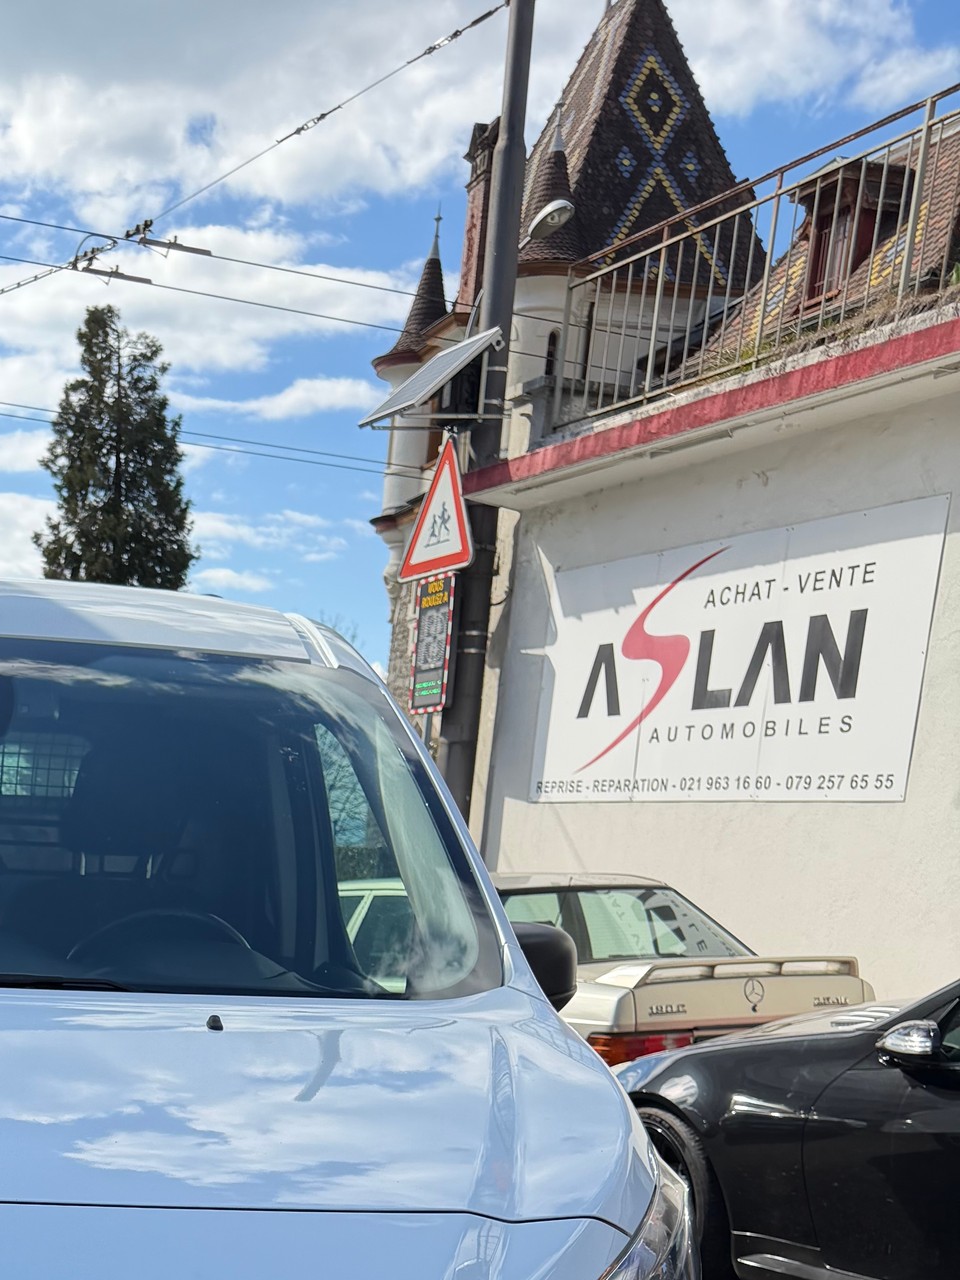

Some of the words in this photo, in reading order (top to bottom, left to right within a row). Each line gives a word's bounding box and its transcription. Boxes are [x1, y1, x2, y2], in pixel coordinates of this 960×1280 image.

[703, 578, 777, 610] ACHAT
[797, 561, 877, 594] VENTE
[573, 545, 869, 774] ASLAN
[648, 714, 855, 744] AUTOMOBILES
[535, 779, 584, 794] REPRISE
[592, 778, 670, 793] REPARATION
[679, 776, 702, 791] 021
[706, 776, 730, 791] 963
[734, 775, 751, 790] 16
[755, 775, 772, 790] 60
[785, 775, 812, 790] 079
[816, 775, 845, 790] 257
[850, 774, 869, 790] 65
[874, 774, 895, 790] 55
